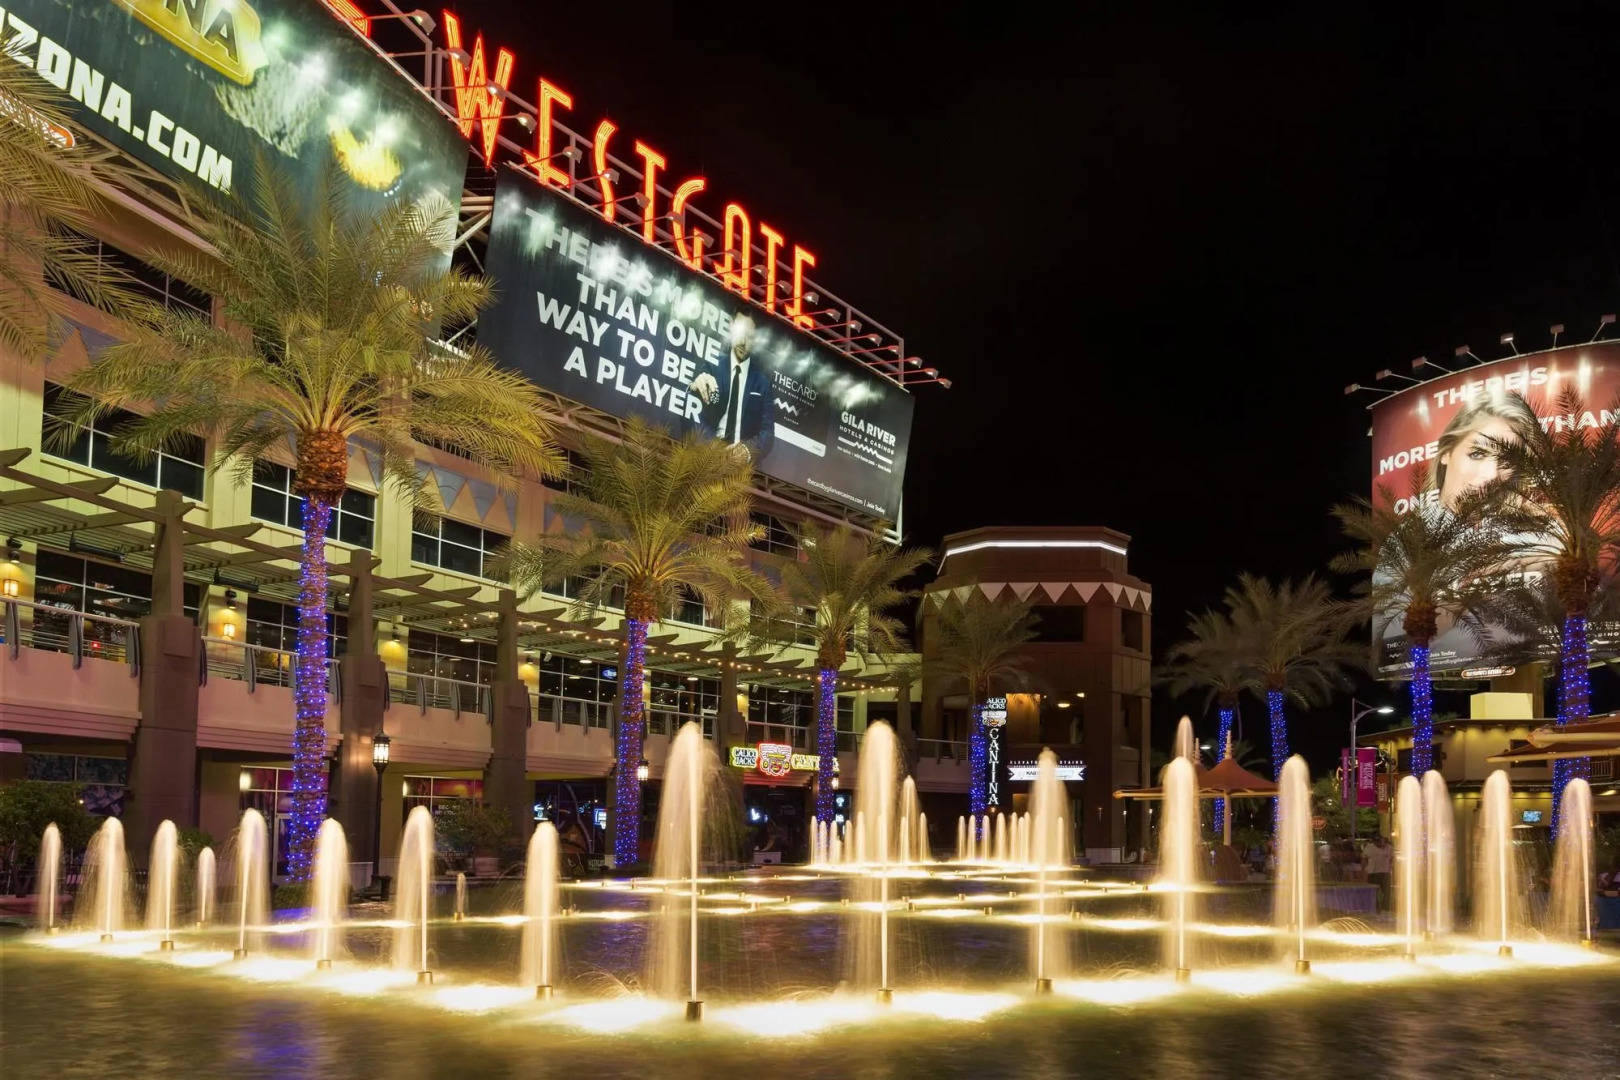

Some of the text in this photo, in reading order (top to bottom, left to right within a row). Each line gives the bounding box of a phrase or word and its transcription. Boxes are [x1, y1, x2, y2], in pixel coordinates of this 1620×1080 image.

[443, 9, 816, 330] WESTGATE
[537, 291, 697, 386] WAY TO BE
[576, 272, 722, 366] THAN ONE
[663, 278, 735, 340] MORE
[563, 346, 703, 424] A PLAYER
[839, 425, 862, 440] HOTELS
[870, 440, 895, 455] CASINOS
[841, 411, 896, 447] GILA RIVER
[1379, 440, 1440, 475] MORE
[1393, 488, 1440, 516] ONE
[987, 728, 1000, 805] CANTINA
